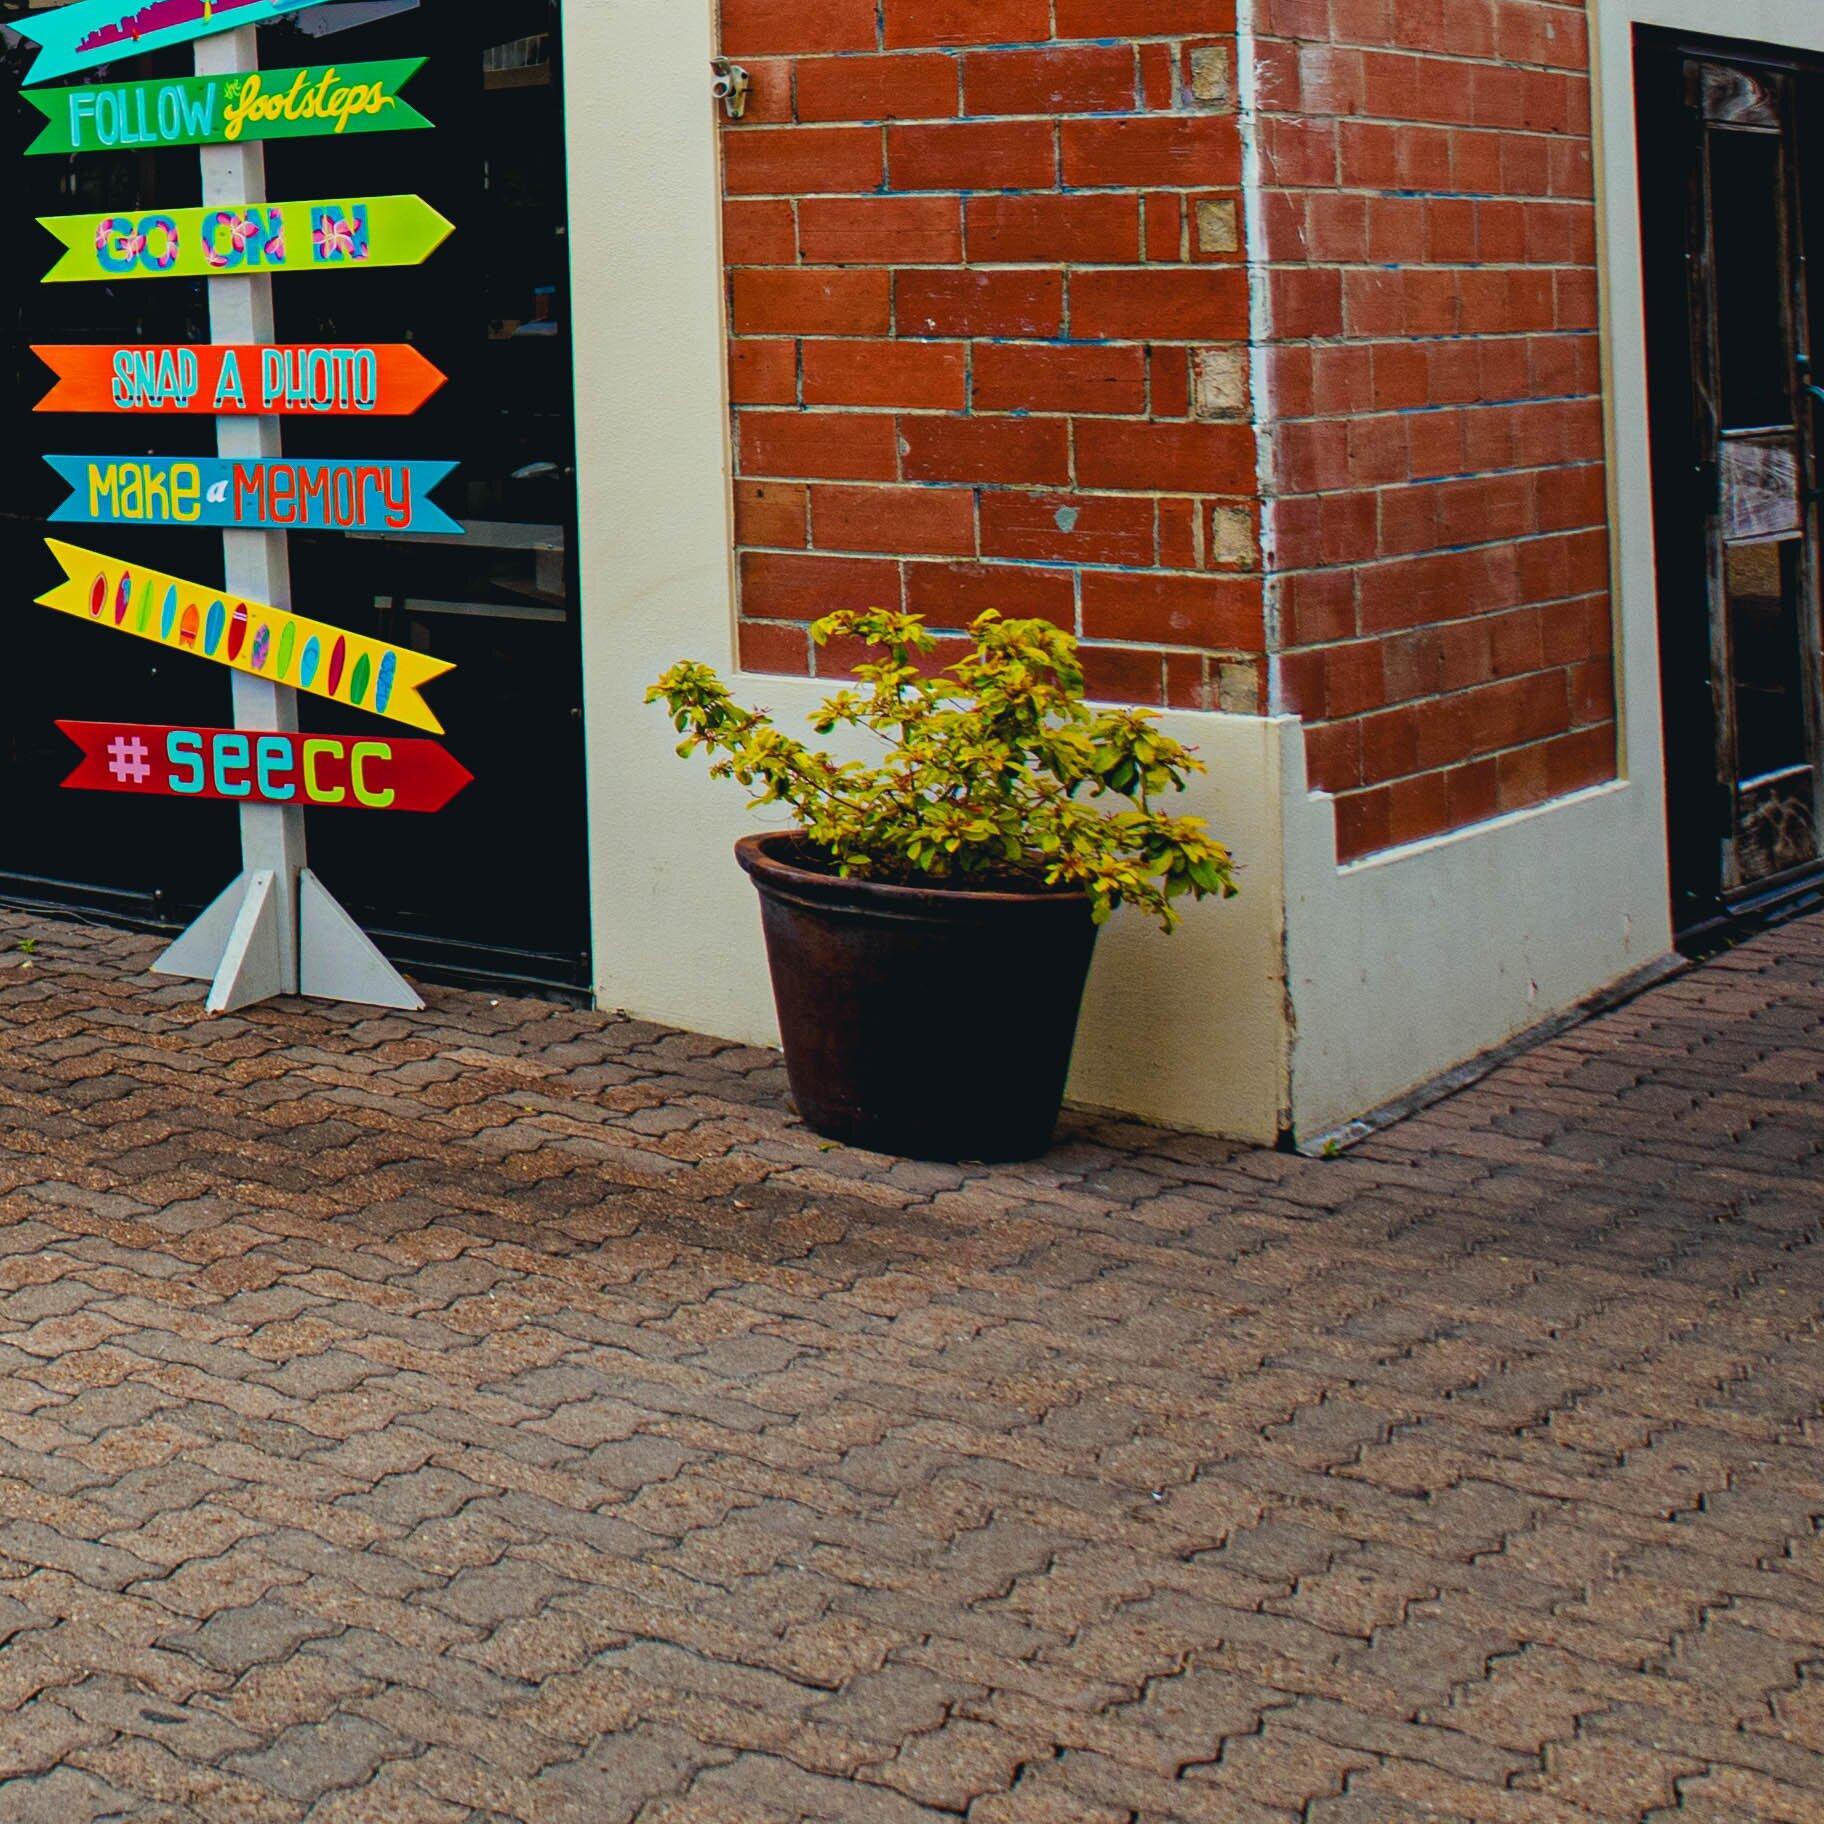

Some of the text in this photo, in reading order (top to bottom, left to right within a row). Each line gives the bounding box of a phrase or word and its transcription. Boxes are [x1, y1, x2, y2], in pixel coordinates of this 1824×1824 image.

[68, 81, 216, 149] FOLLOW
[223, 68, 397, 142] footsteps
[95, 204, 369, 273] GO ON IN
[112, 348, 378, 412] SNAP A PHOTO
[206, 479, 228, 504] a
